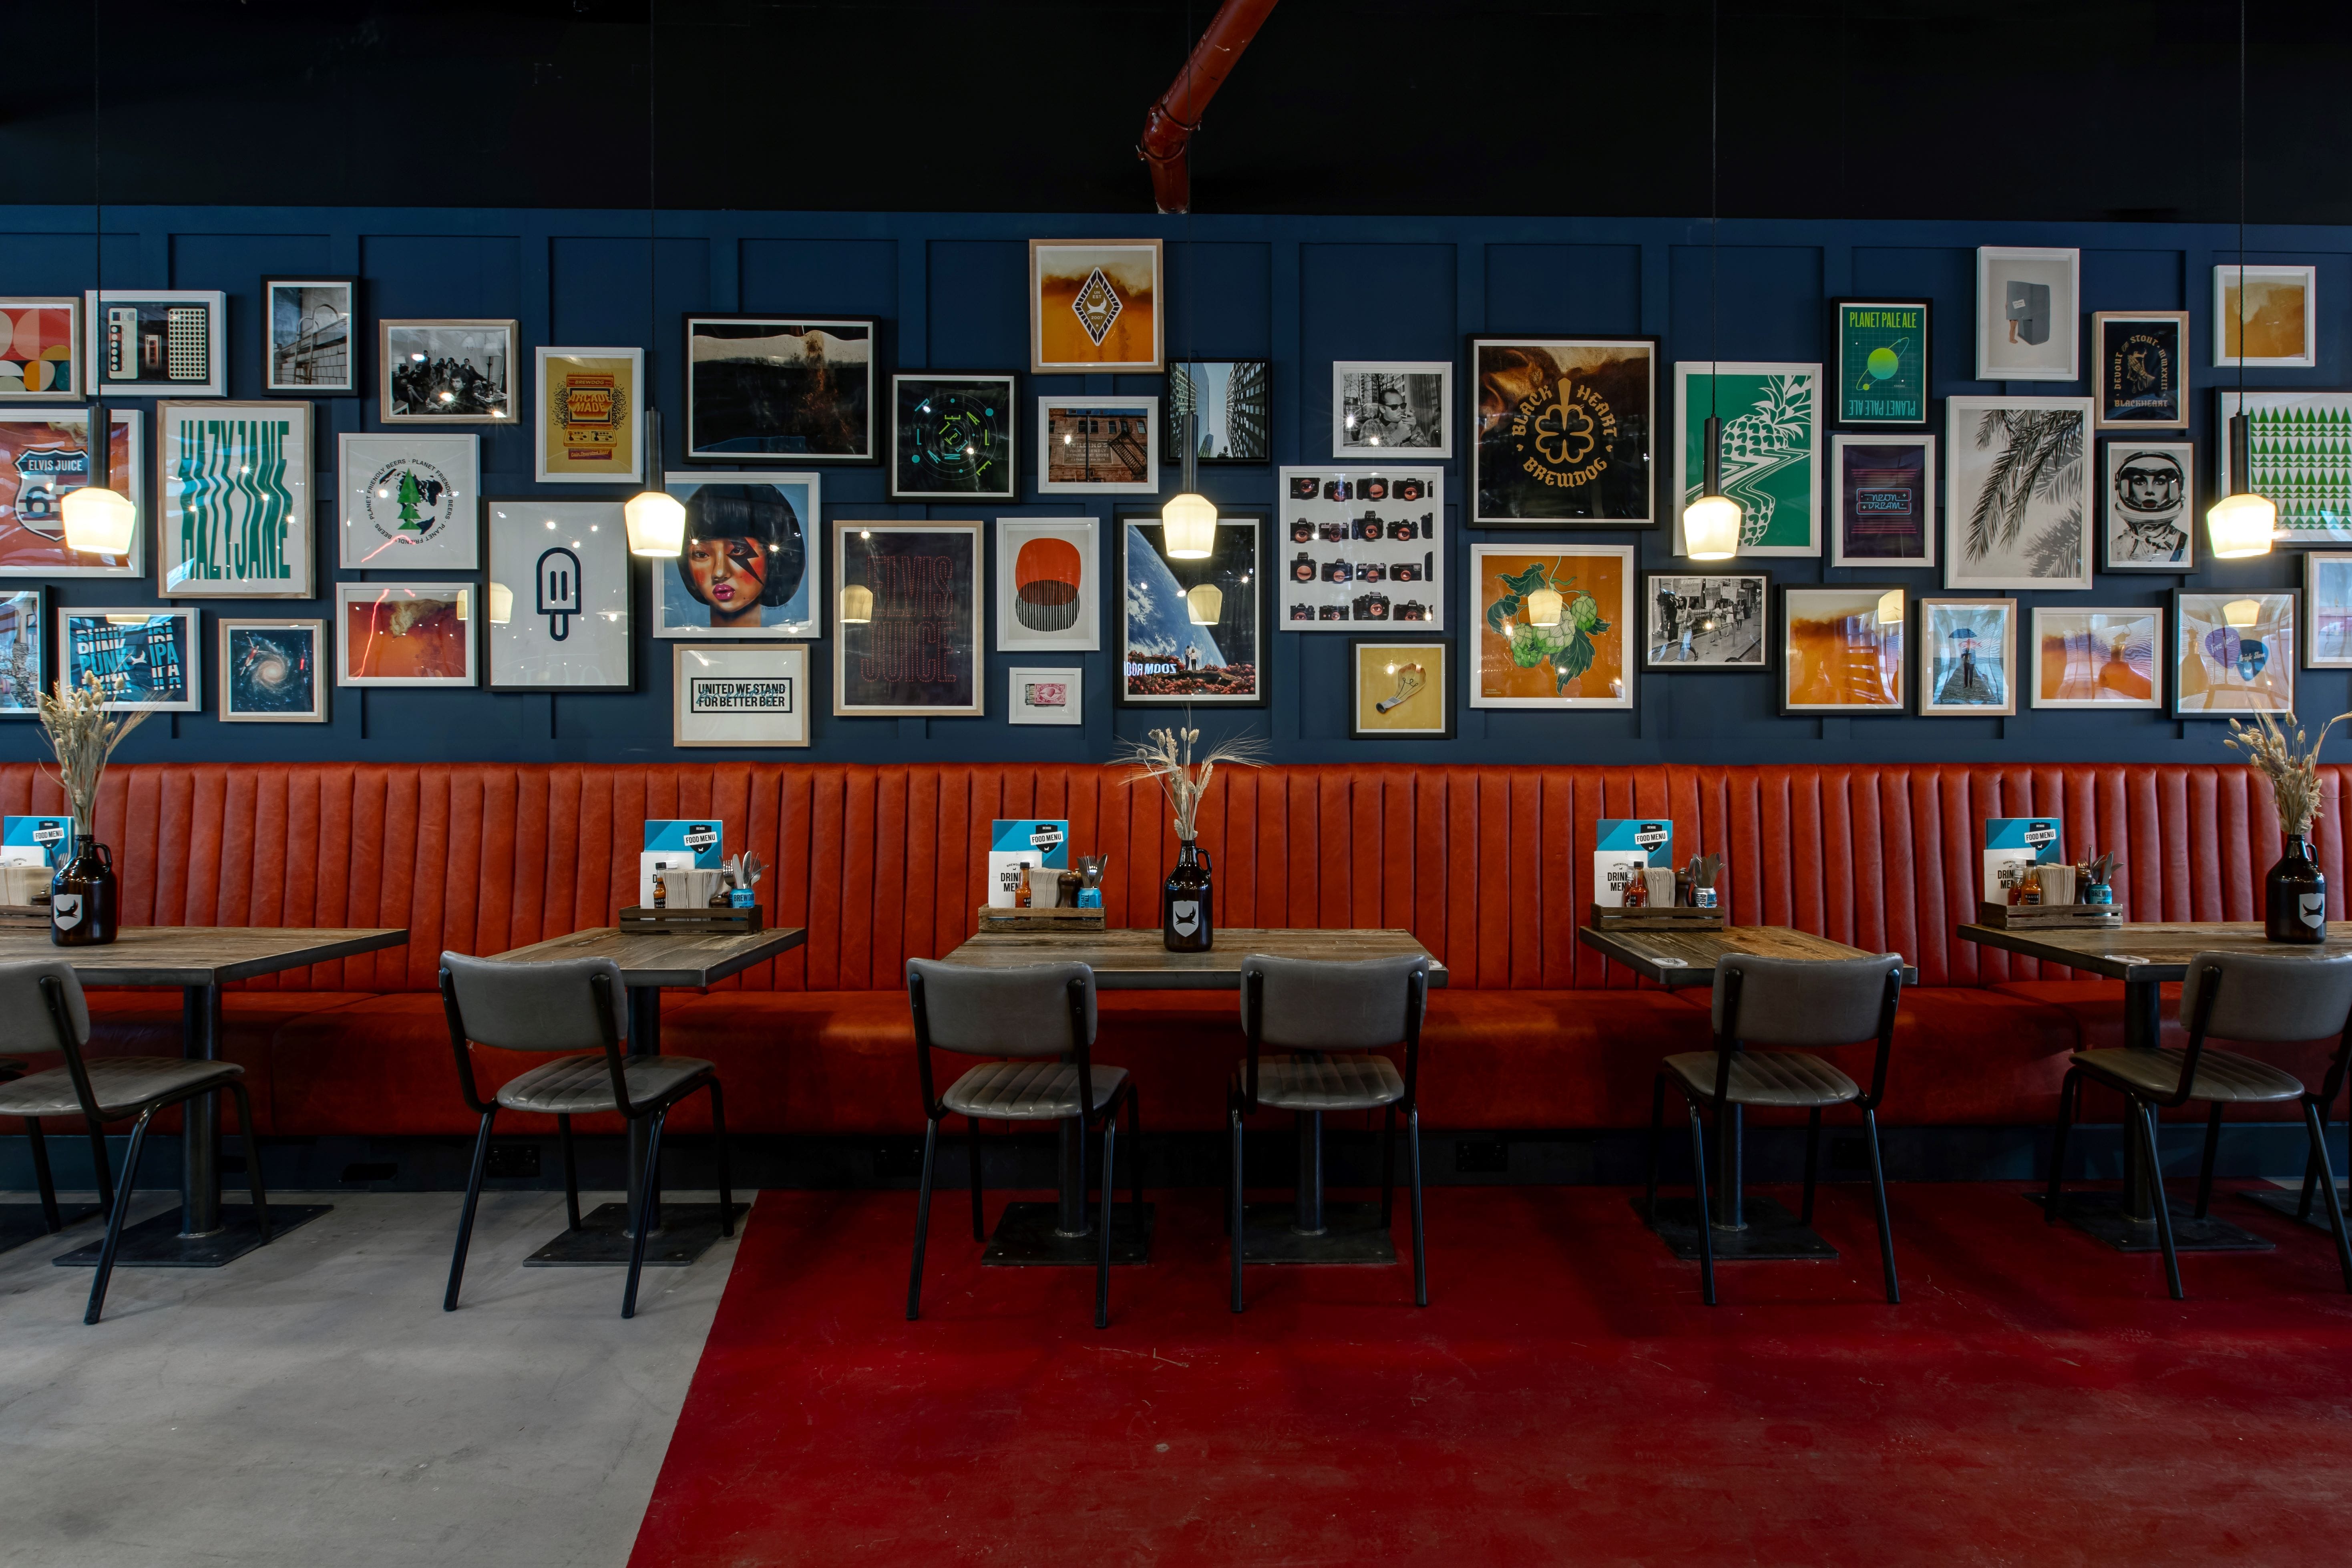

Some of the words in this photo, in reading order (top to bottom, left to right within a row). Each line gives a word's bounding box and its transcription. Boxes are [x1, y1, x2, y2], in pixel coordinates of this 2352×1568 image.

[1849, 312, 1880, 328] PLANET
[1882, 312, 1901, 328] PALE
[1902, 313, 1917, 328] ALE
[573, 402, 607, 412] MADE
[1512, 385, 1553, 436] BLACK
[1576, 385, 1617, 437] HEART
[1849, 400, 1862, 415] ALE
[1865, 400, 1884, 415] PALE
[1886, 400, 1916, 416] PLANET
[28, 460, 53, 471] ELVIS
[55, 460, 83, 471] JUICE
[386, 458, 406, 470] BEERS
[1523, 457, 1607, 488] BREWDOG
[367, 467, 386, 494] FRIENDLY
[412, 458, 436, 471] PLANET
[435, 470, 453, 497] FRIENDLY
[445, 499, 453, 520] BEERS
[366, 496, 375, 521] PLANET
[374, 523, 393, 539] BEERS
[425, 523, 446, 541] PLANET
[867, 555, 953, 617] ELVIS
[860, 621, 957, 682] JUICE
[698, 683, 734, 694] UNITED
[736, 683, 751, 694] WE
[753, 683, 786, 694] STAND
[698, 696, 718, 707] FOR
[720, 696, 758, 707] BETTER
[759, 696, 785, 707] BEER
[48, 830, 63, 838] MENU
[686, 836, 700, 844] FOOD
[700, 834, 716, 842] MENU
[1031, 835, 1045, 843] FOOD
[1046, 833, 1061, 842] MENU
[1636, 834, 1650, 842] FOOD
[1650, 832, 1666, 841] MENU
[2026, 832, 2039, 841] FOOD
[2039, 831, 2054, 839] MENU
[1998, 870, 2014, 879] DRIN
[1003, 883, 1019, 892] MEN
[1610, 882, 1626, 891] MEN
